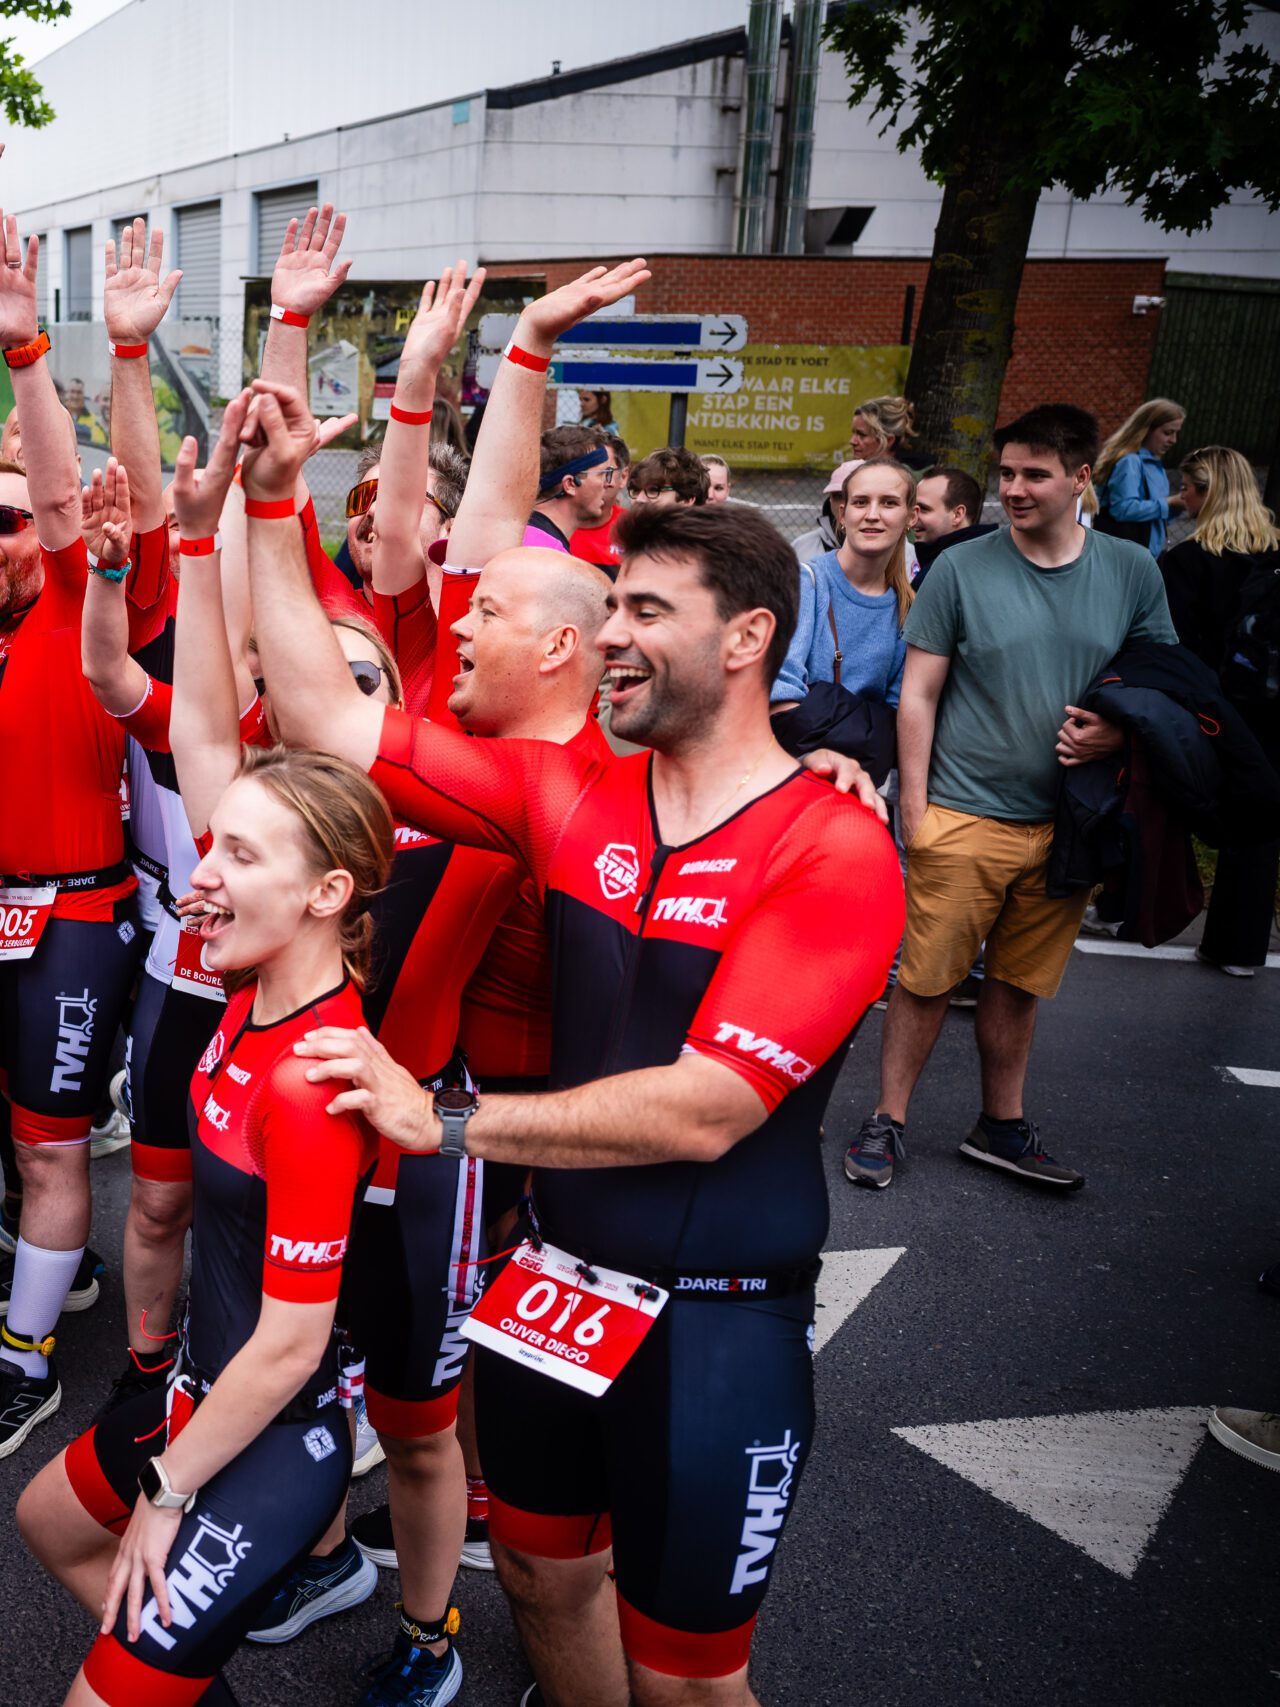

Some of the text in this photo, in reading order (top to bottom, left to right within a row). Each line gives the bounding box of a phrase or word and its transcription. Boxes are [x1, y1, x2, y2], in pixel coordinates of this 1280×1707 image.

[756, 356, 782, 366] STAD
[785, 357, 798, 366] TE
[801, 356, 830, 367] VOET
[799, 378, 852, 395] ELKE
[702, 394, 794, 412] STAP EEN
[686, 412, 825, 432] NTDEKKING IS
[722, 440, 744, 450] ELKE
[747, 441, 770, 450] STAP
[773, 442, 794, 451] TELT
[678, 859, 737, 876] BIORACER
[180, 967, 192, 978] DE
[270, 1234, 327, 1263] TVH
[675, 1277, 767, 1291] DARE2TRI
[516, 1280, 611, 1346] 016
[500, 1317, 590, 1365] OLIVER DIEGO
[729, 1493, 789, 1594] TVH
